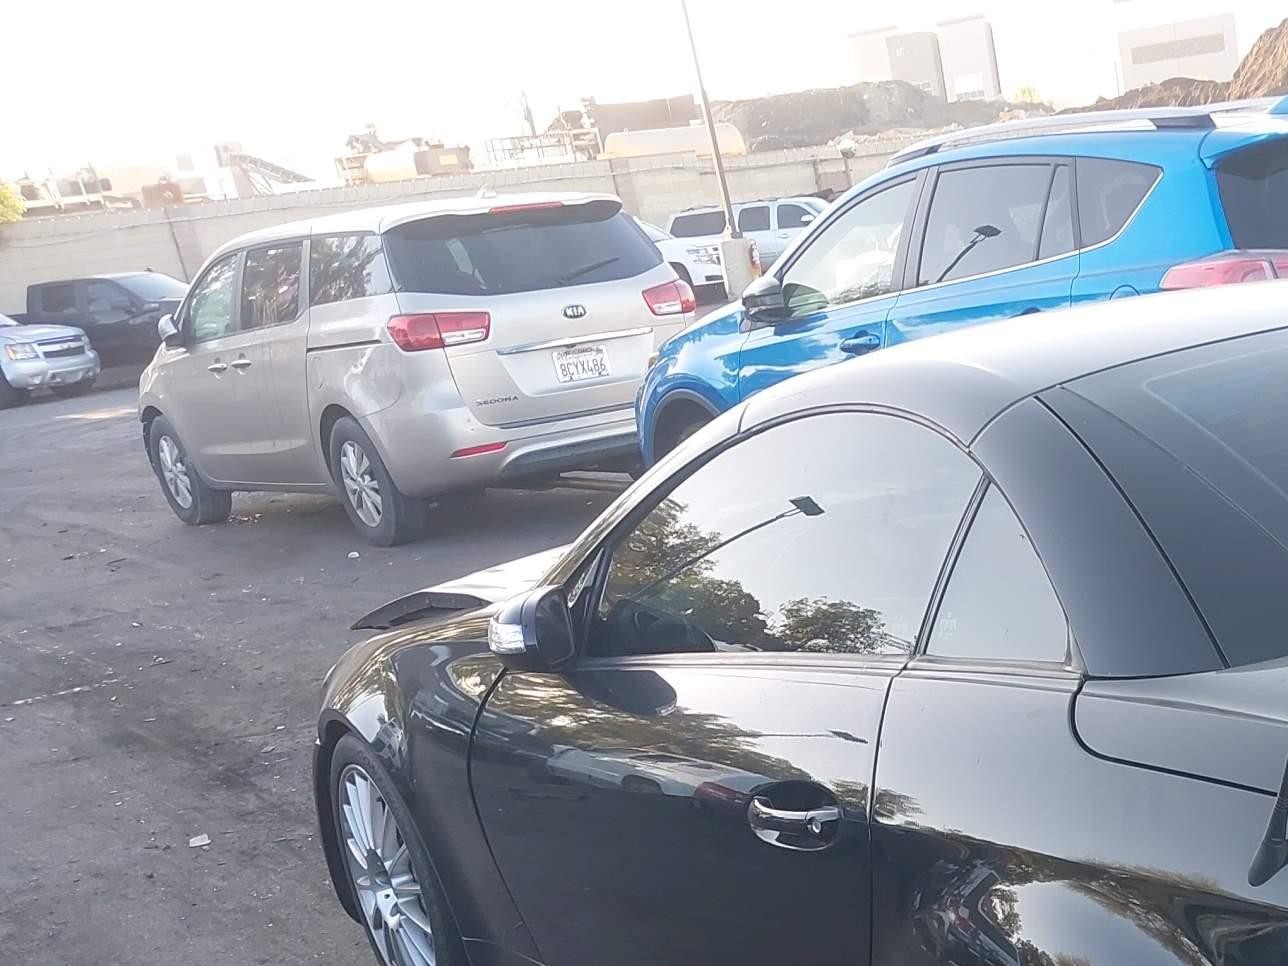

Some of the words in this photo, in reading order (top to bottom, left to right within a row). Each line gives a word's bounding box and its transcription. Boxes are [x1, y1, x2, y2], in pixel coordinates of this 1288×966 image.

[563, 305, 586, 318] KIA
[560, 358, 606, 376] 8CYX486
[475, 396, 519, 406] SEDONA
